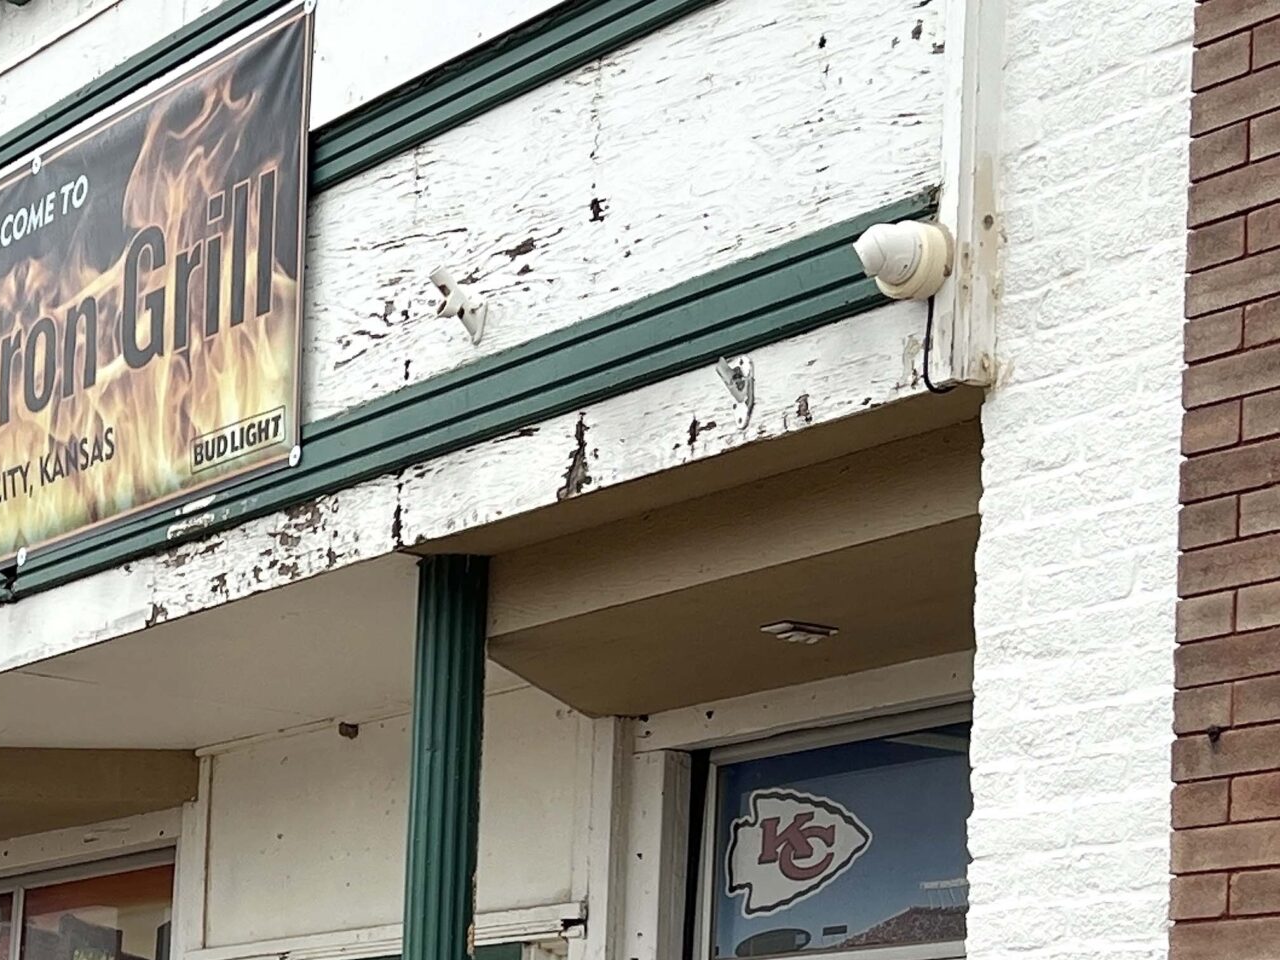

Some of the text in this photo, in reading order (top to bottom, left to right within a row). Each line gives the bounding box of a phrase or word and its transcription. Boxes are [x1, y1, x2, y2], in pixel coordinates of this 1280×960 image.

[60, 174, 89, 216] TO
[122, 168, 277, 369] Grill
[39, 426, 116, 487] KANSAS
[193, 414, 282, 466] BUD LIGHT
[757, 811, 836, 881] KC
